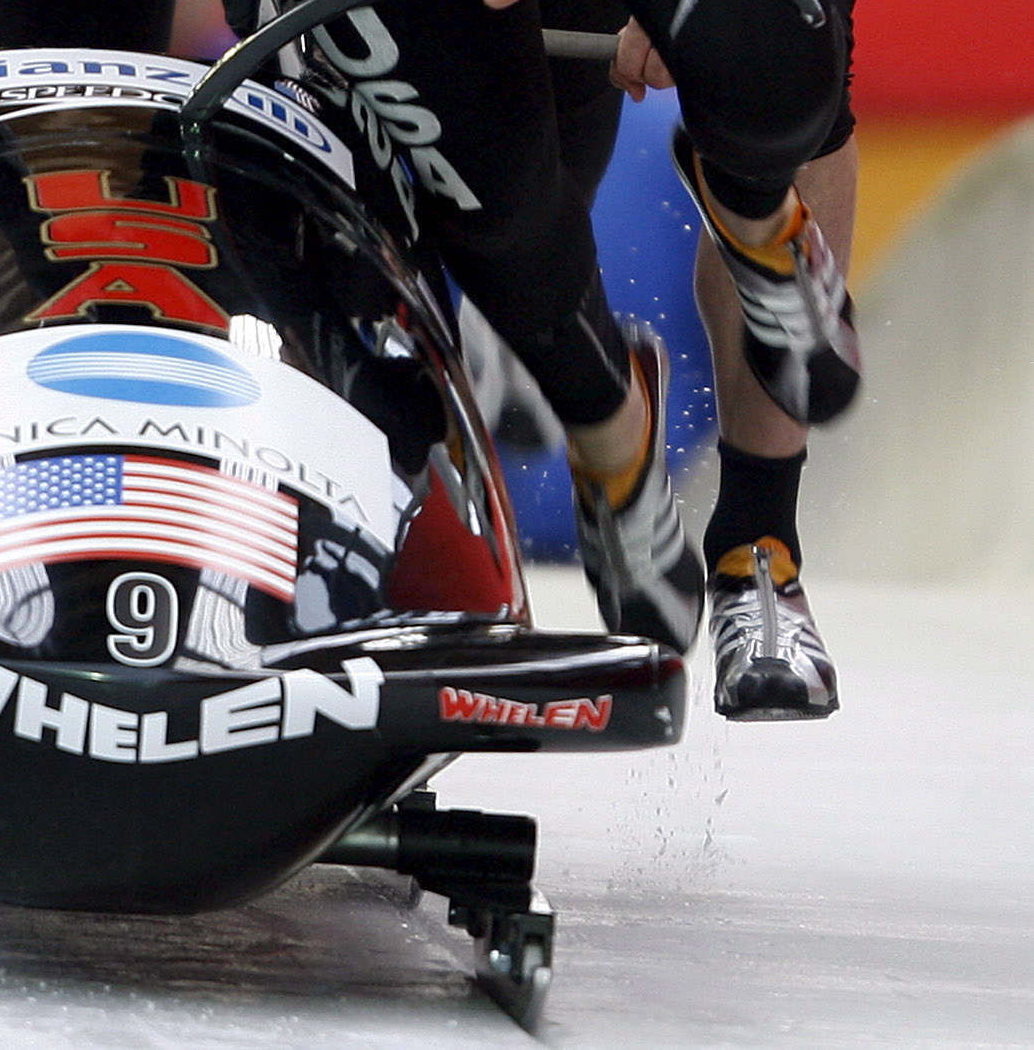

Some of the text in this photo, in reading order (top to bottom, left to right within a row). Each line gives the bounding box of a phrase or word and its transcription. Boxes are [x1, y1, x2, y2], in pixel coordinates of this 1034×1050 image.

[311, 6, 483, 211] USA
[23, 169, 230, 330] USA
[139, 417, 373, 524] MINOLTA
[105, 571, 180, 667] 9
[437, 685, 614, 733] WHELEN
